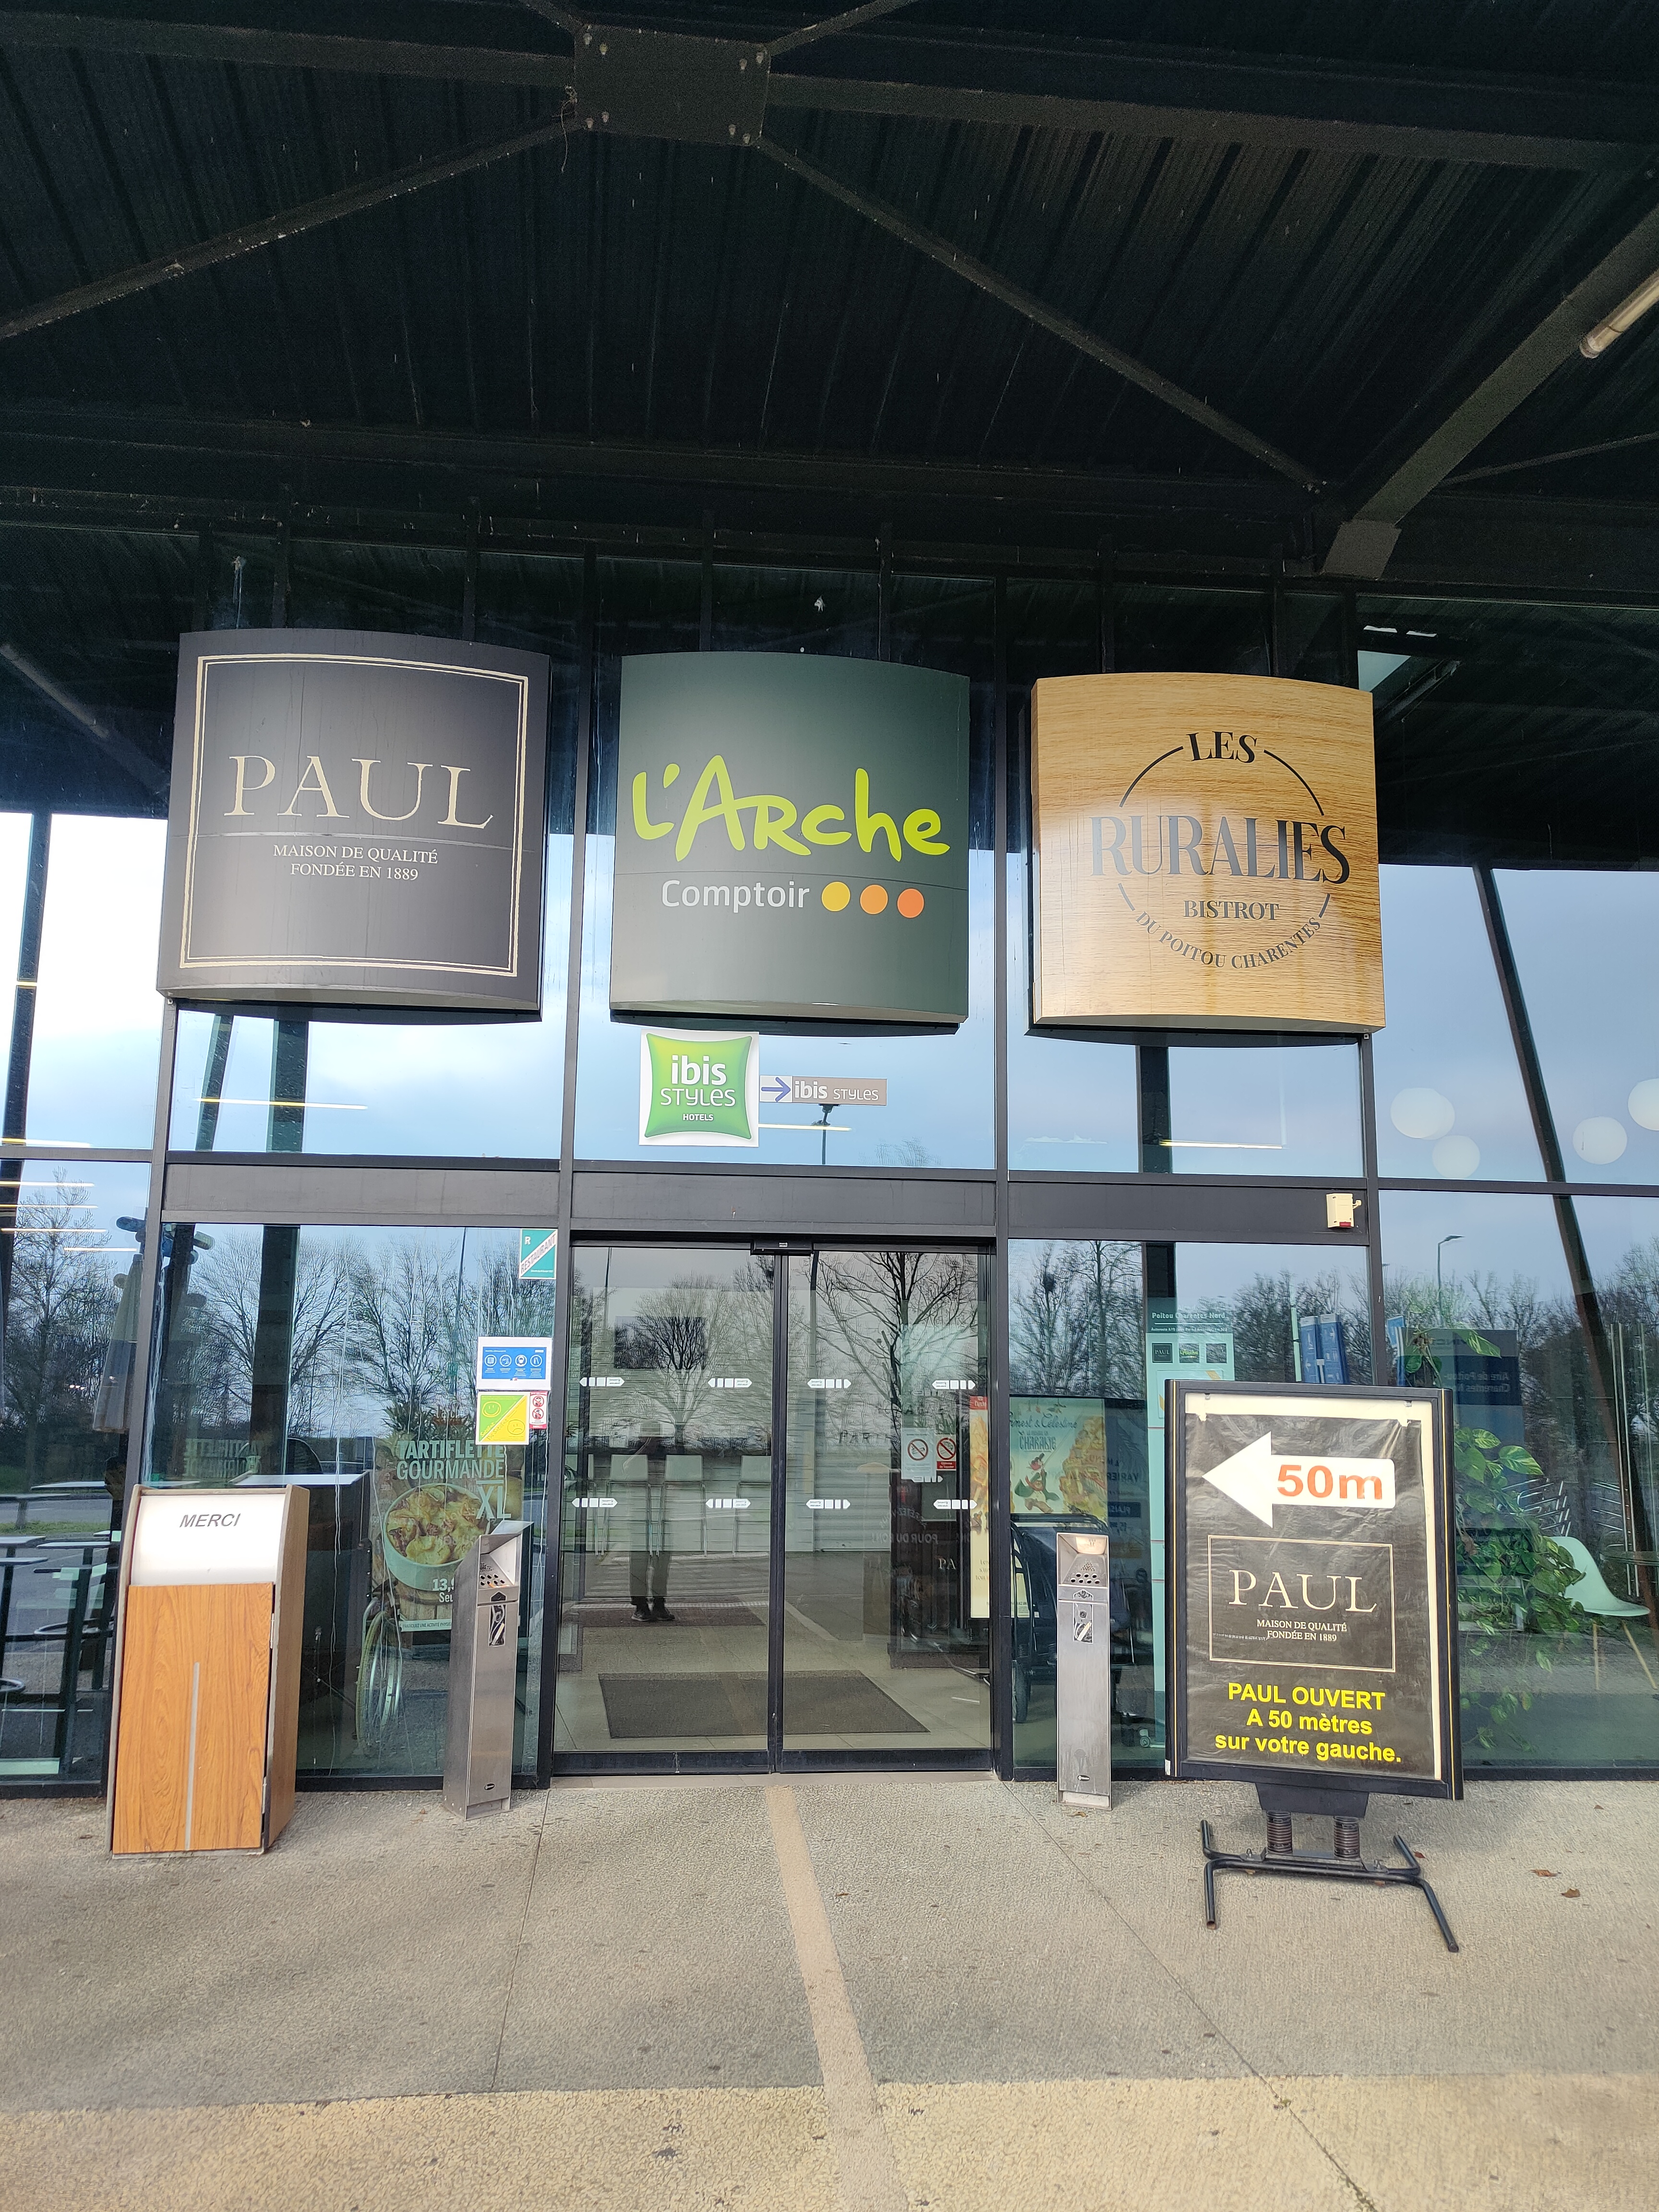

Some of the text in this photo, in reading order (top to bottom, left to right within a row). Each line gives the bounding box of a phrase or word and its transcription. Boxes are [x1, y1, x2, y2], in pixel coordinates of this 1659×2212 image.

[1186, 731, 1257, 763] LES
[224, 755, 493, 829] PAUL
[632, 755, 950, 862] L'Arche
[273, 844, 438, 864] MAISON DE QUALITÉ
[1089, 815, 1349, 884] RURALIES
[290, 862, 419, 881] FONDÉE EN 1889
[662, 879, 810, 913] Comptoir
[1183, 900, 1279, 921] BISTROT
[1136, 911, 1321, 969] DU POITOU CHARENTES
[672, 1055, 727, 1085] ibis
[795, 1081, 828, 1099] ibis
[683, 1113, 714, 1121] HOTELS
[521, 1233, 556, 1274] RESTAURANT
[525, 1236, 531, 1245] R
[397, 1459, 504, 1480] GOURMANDE
[1277, 1465, 1382, 1500] 50m
[476, 1486, 511, 1519] XL
[180, 1513, 240, 1528] MERCI
[1229, 1570, 1377, 1612] PAUL
[1257, 1619, 1292, 1629] MAISON
[1308, 1623, 1347, 1632] QUALITÉ
[1267, 1630, 1302, 1640] FONDÉE
[1228, 1683, 1385, 1710] PAUL OUVERT
[1246, 1708, 1372, 1735] A 50 mètres
[1215, 1734, 1402, 1763] sur votre gauche.
